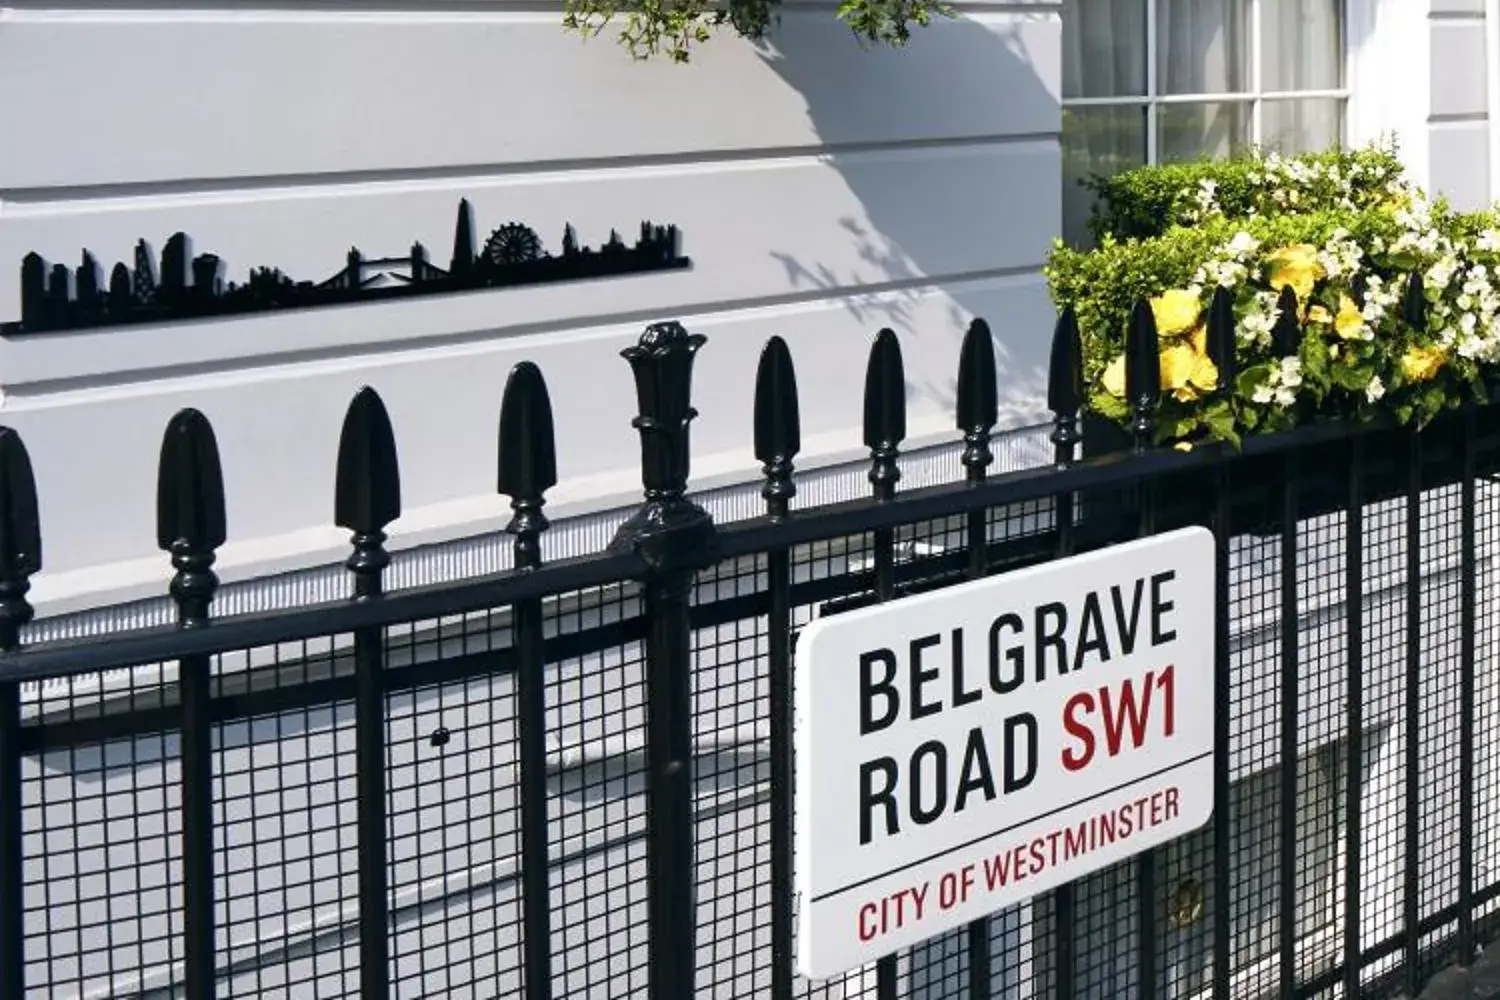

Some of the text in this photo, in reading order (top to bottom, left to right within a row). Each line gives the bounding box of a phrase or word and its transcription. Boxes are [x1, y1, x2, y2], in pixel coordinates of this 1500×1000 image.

[859, 570, 1177, 736] BELGRAVE
[859, 664, 1175, 846] ROAD SW1
[858, 786, 1179, 942] CITY OF WESTMINSTER
